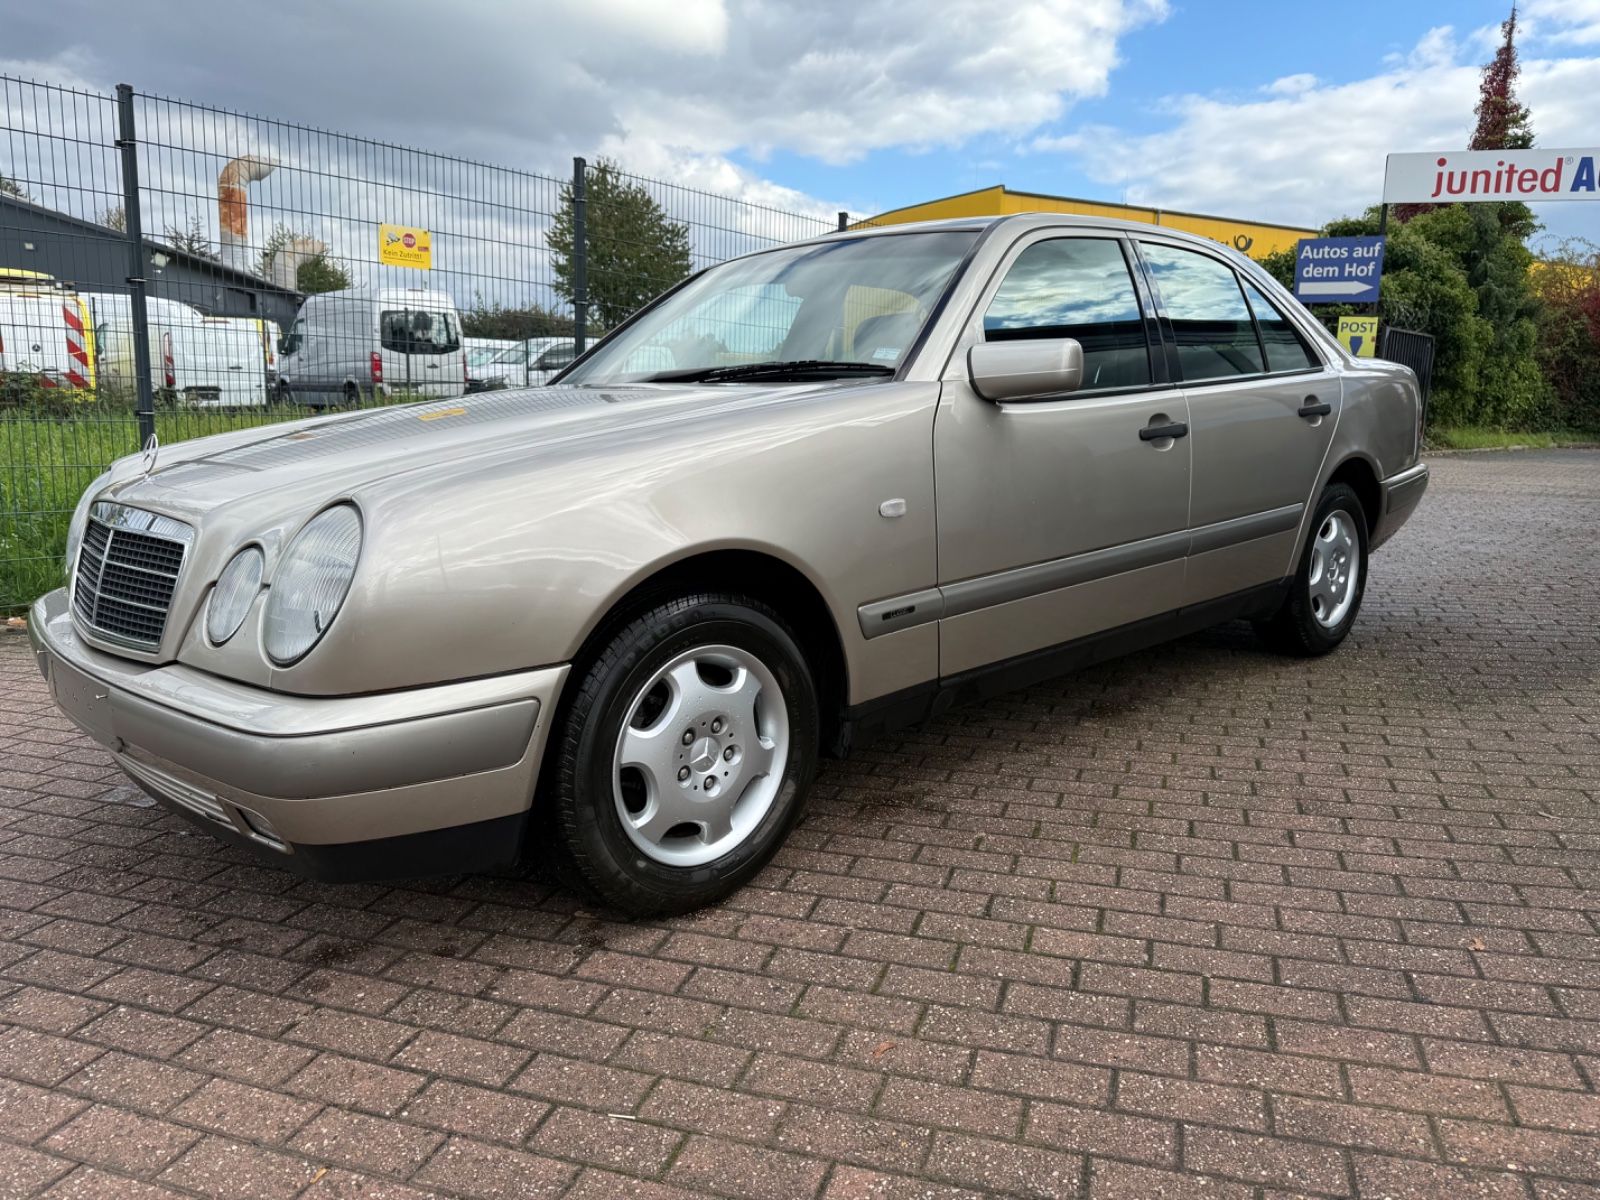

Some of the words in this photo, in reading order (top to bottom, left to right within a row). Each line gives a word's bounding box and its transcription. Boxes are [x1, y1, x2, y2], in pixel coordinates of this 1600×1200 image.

[1570, 156, 1600, 192] A
[1300, 245, 1349, 260] Autos
[1352, 242, 1382, 258] auf
[1302, 263, 1339, 278] dem
[1344, 261, 1376, 277] Hof
[1340, 321, 1377, 333] POST
